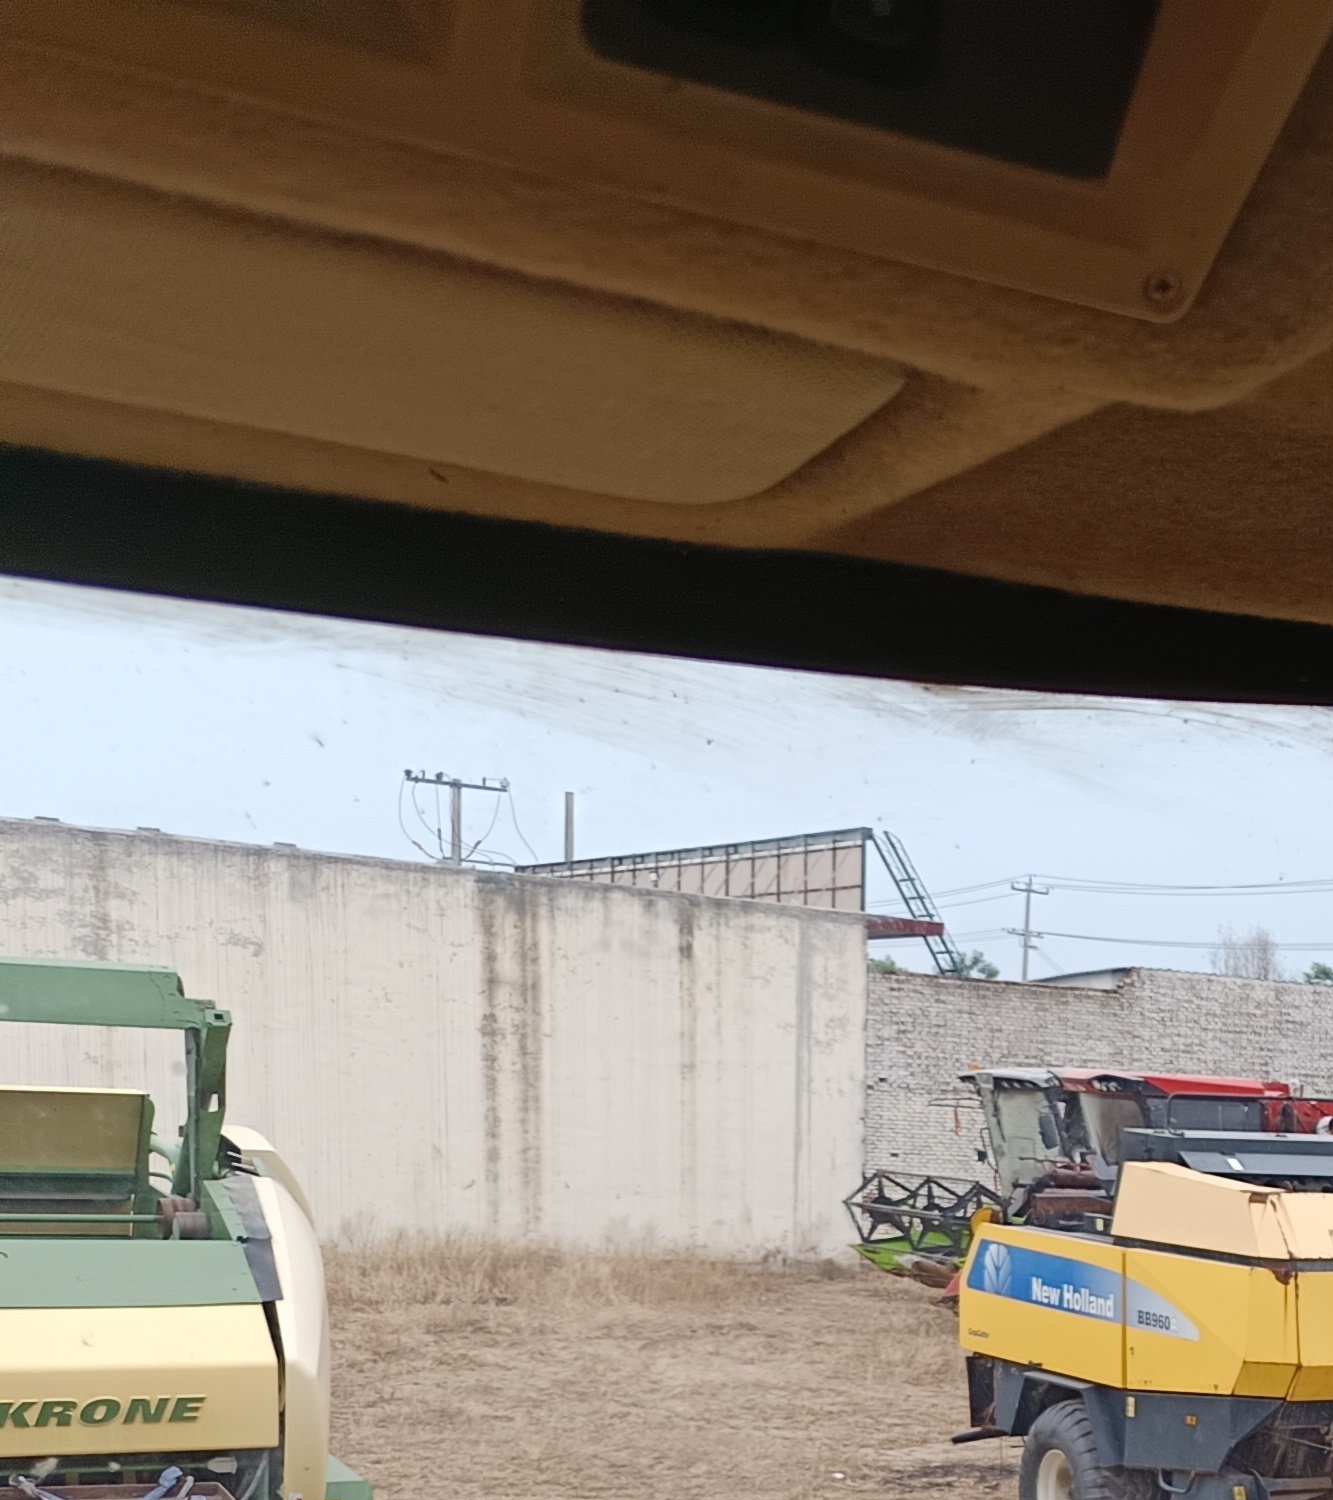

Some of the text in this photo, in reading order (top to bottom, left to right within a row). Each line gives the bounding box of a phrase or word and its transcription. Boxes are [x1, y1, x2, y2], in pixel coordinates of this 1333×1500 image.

[1032, 1276, 1114, 1318] New Holland
[0, 1395, 207, 1429] KRONE
